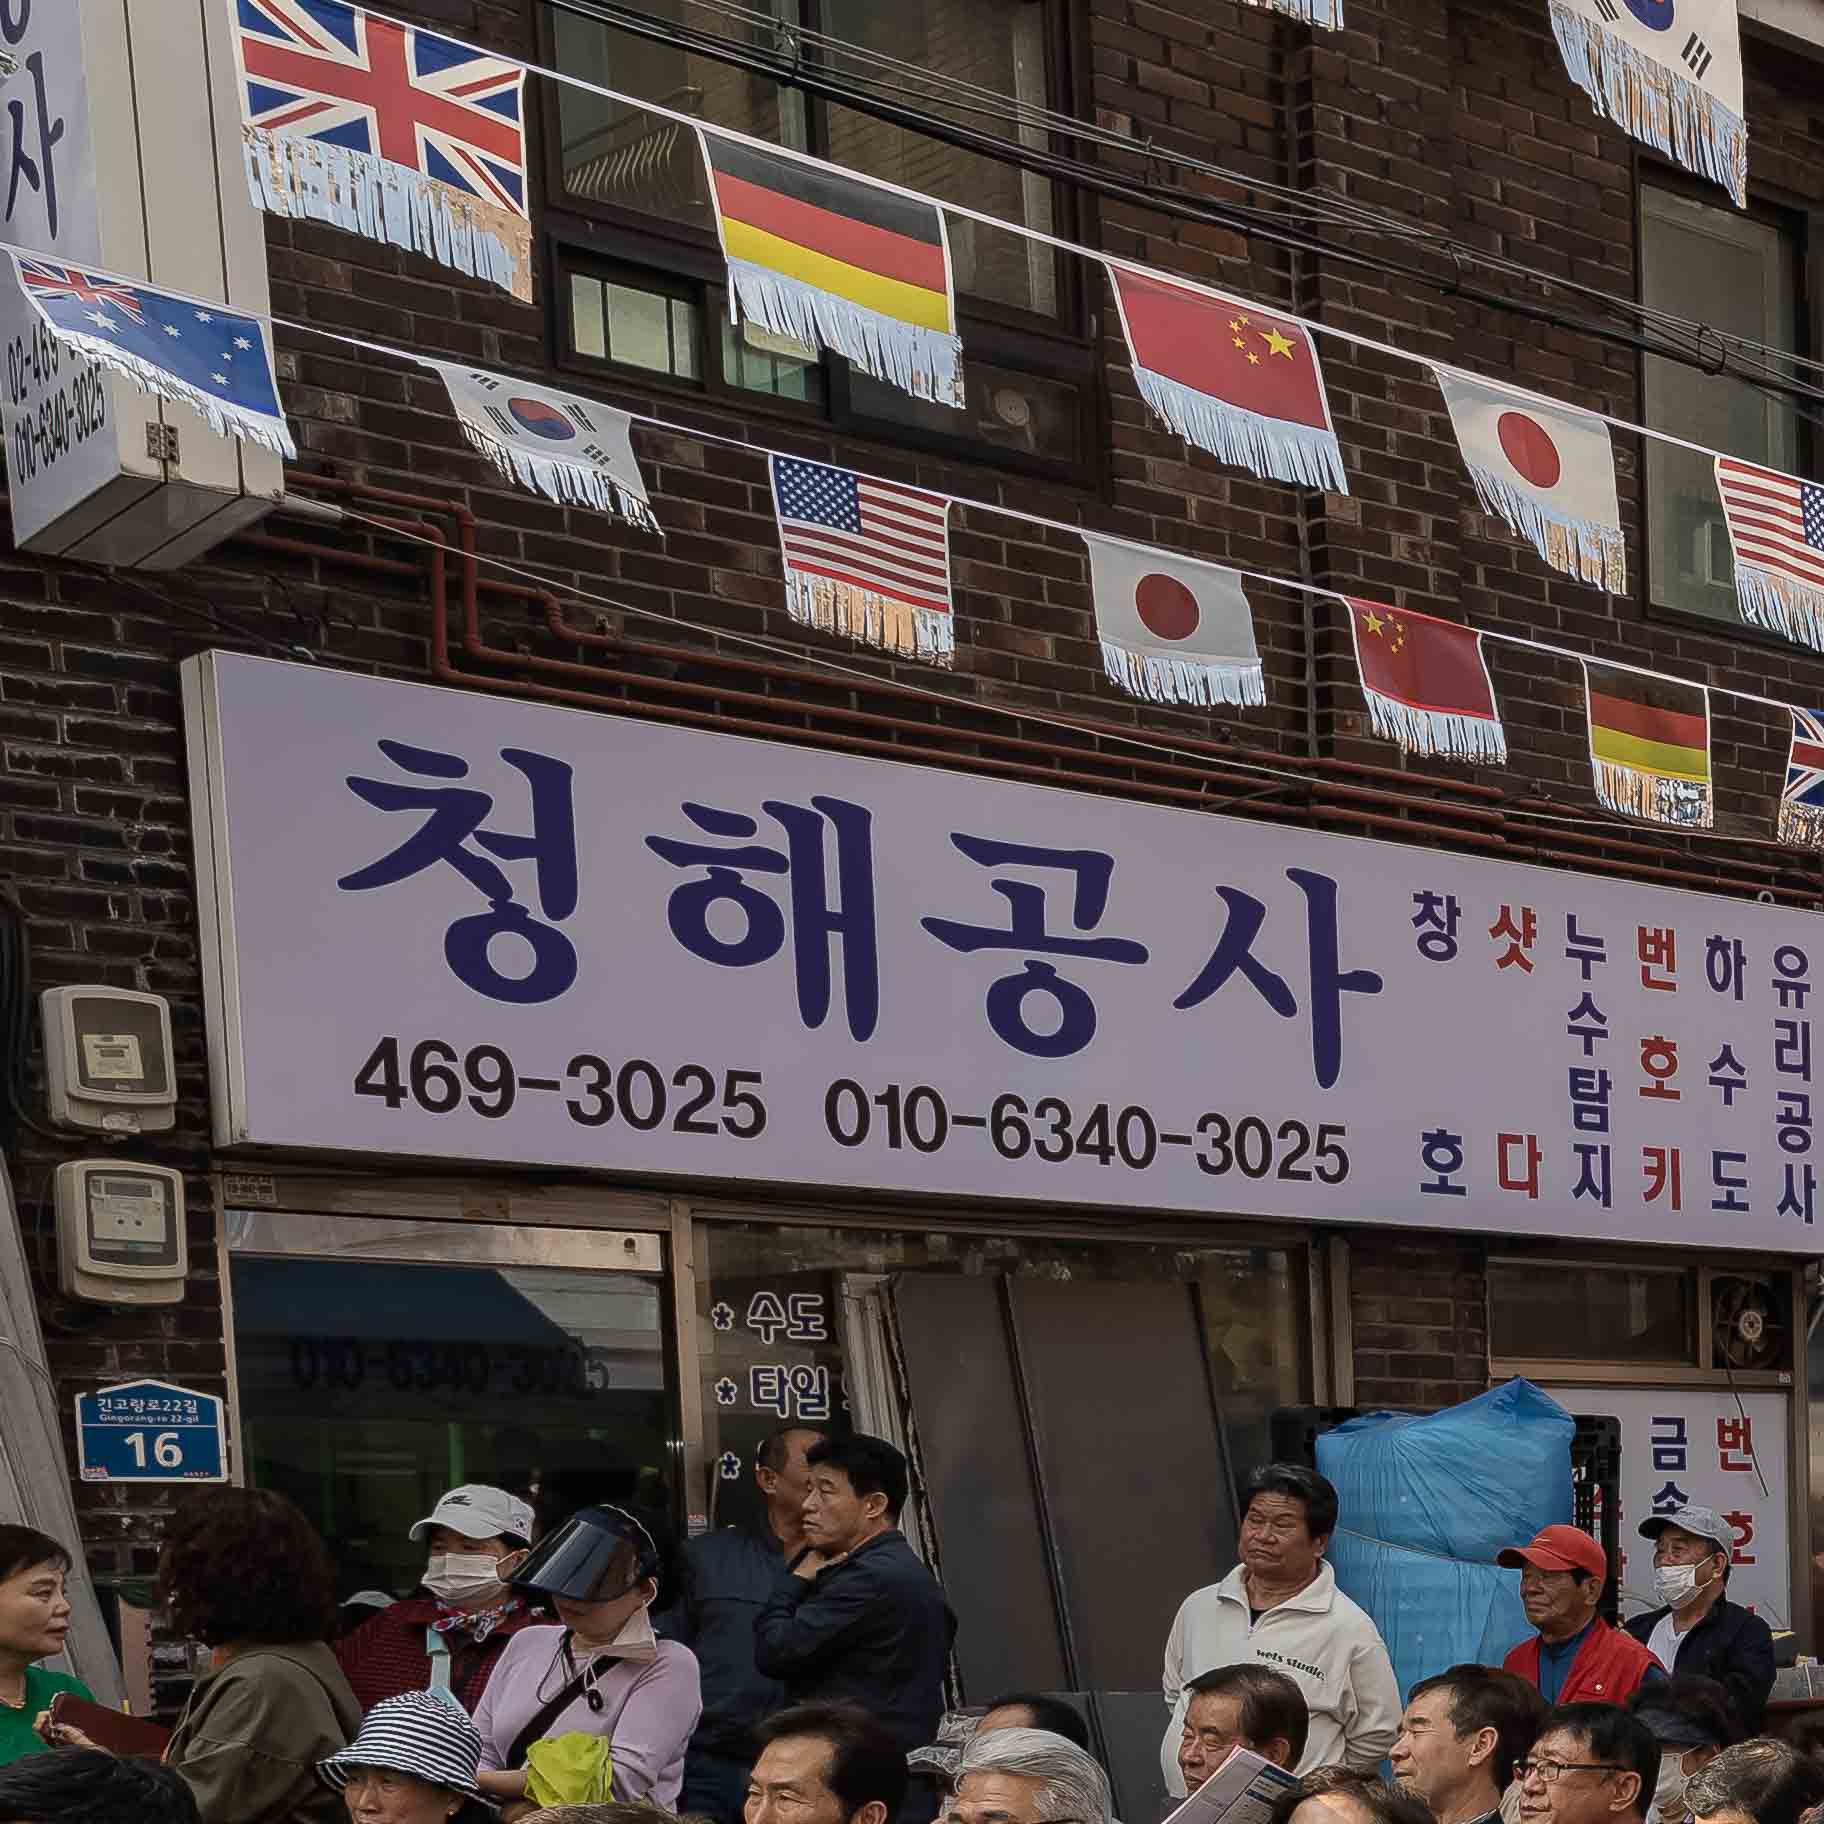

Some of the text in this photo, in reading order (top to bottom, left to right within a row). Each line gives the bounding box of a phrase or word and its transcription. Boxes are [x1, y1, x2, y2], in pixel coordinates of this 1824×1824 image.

[15, 363, 105, 486] 010-6340-3025
[338, 738, 1384, 1091] 청해공사
[354, 1036, 1351, 1184] 469-3025 010-6340-3025
[1564, 913, 1614, 1209] 누수탐지
[1636, 924, 1683, 1211] 번호키
[1704, 934, 1750, 1213] 하수도
[1771, 945, 1817, 1226] 유리공사
[747, 1291, 828, 1344] 수도
[97, 1398, 199, 1414] 긴고랑로22길
[124, 1432, 184, 1468] 16
[750, 1364, 830, 1420] 타일
